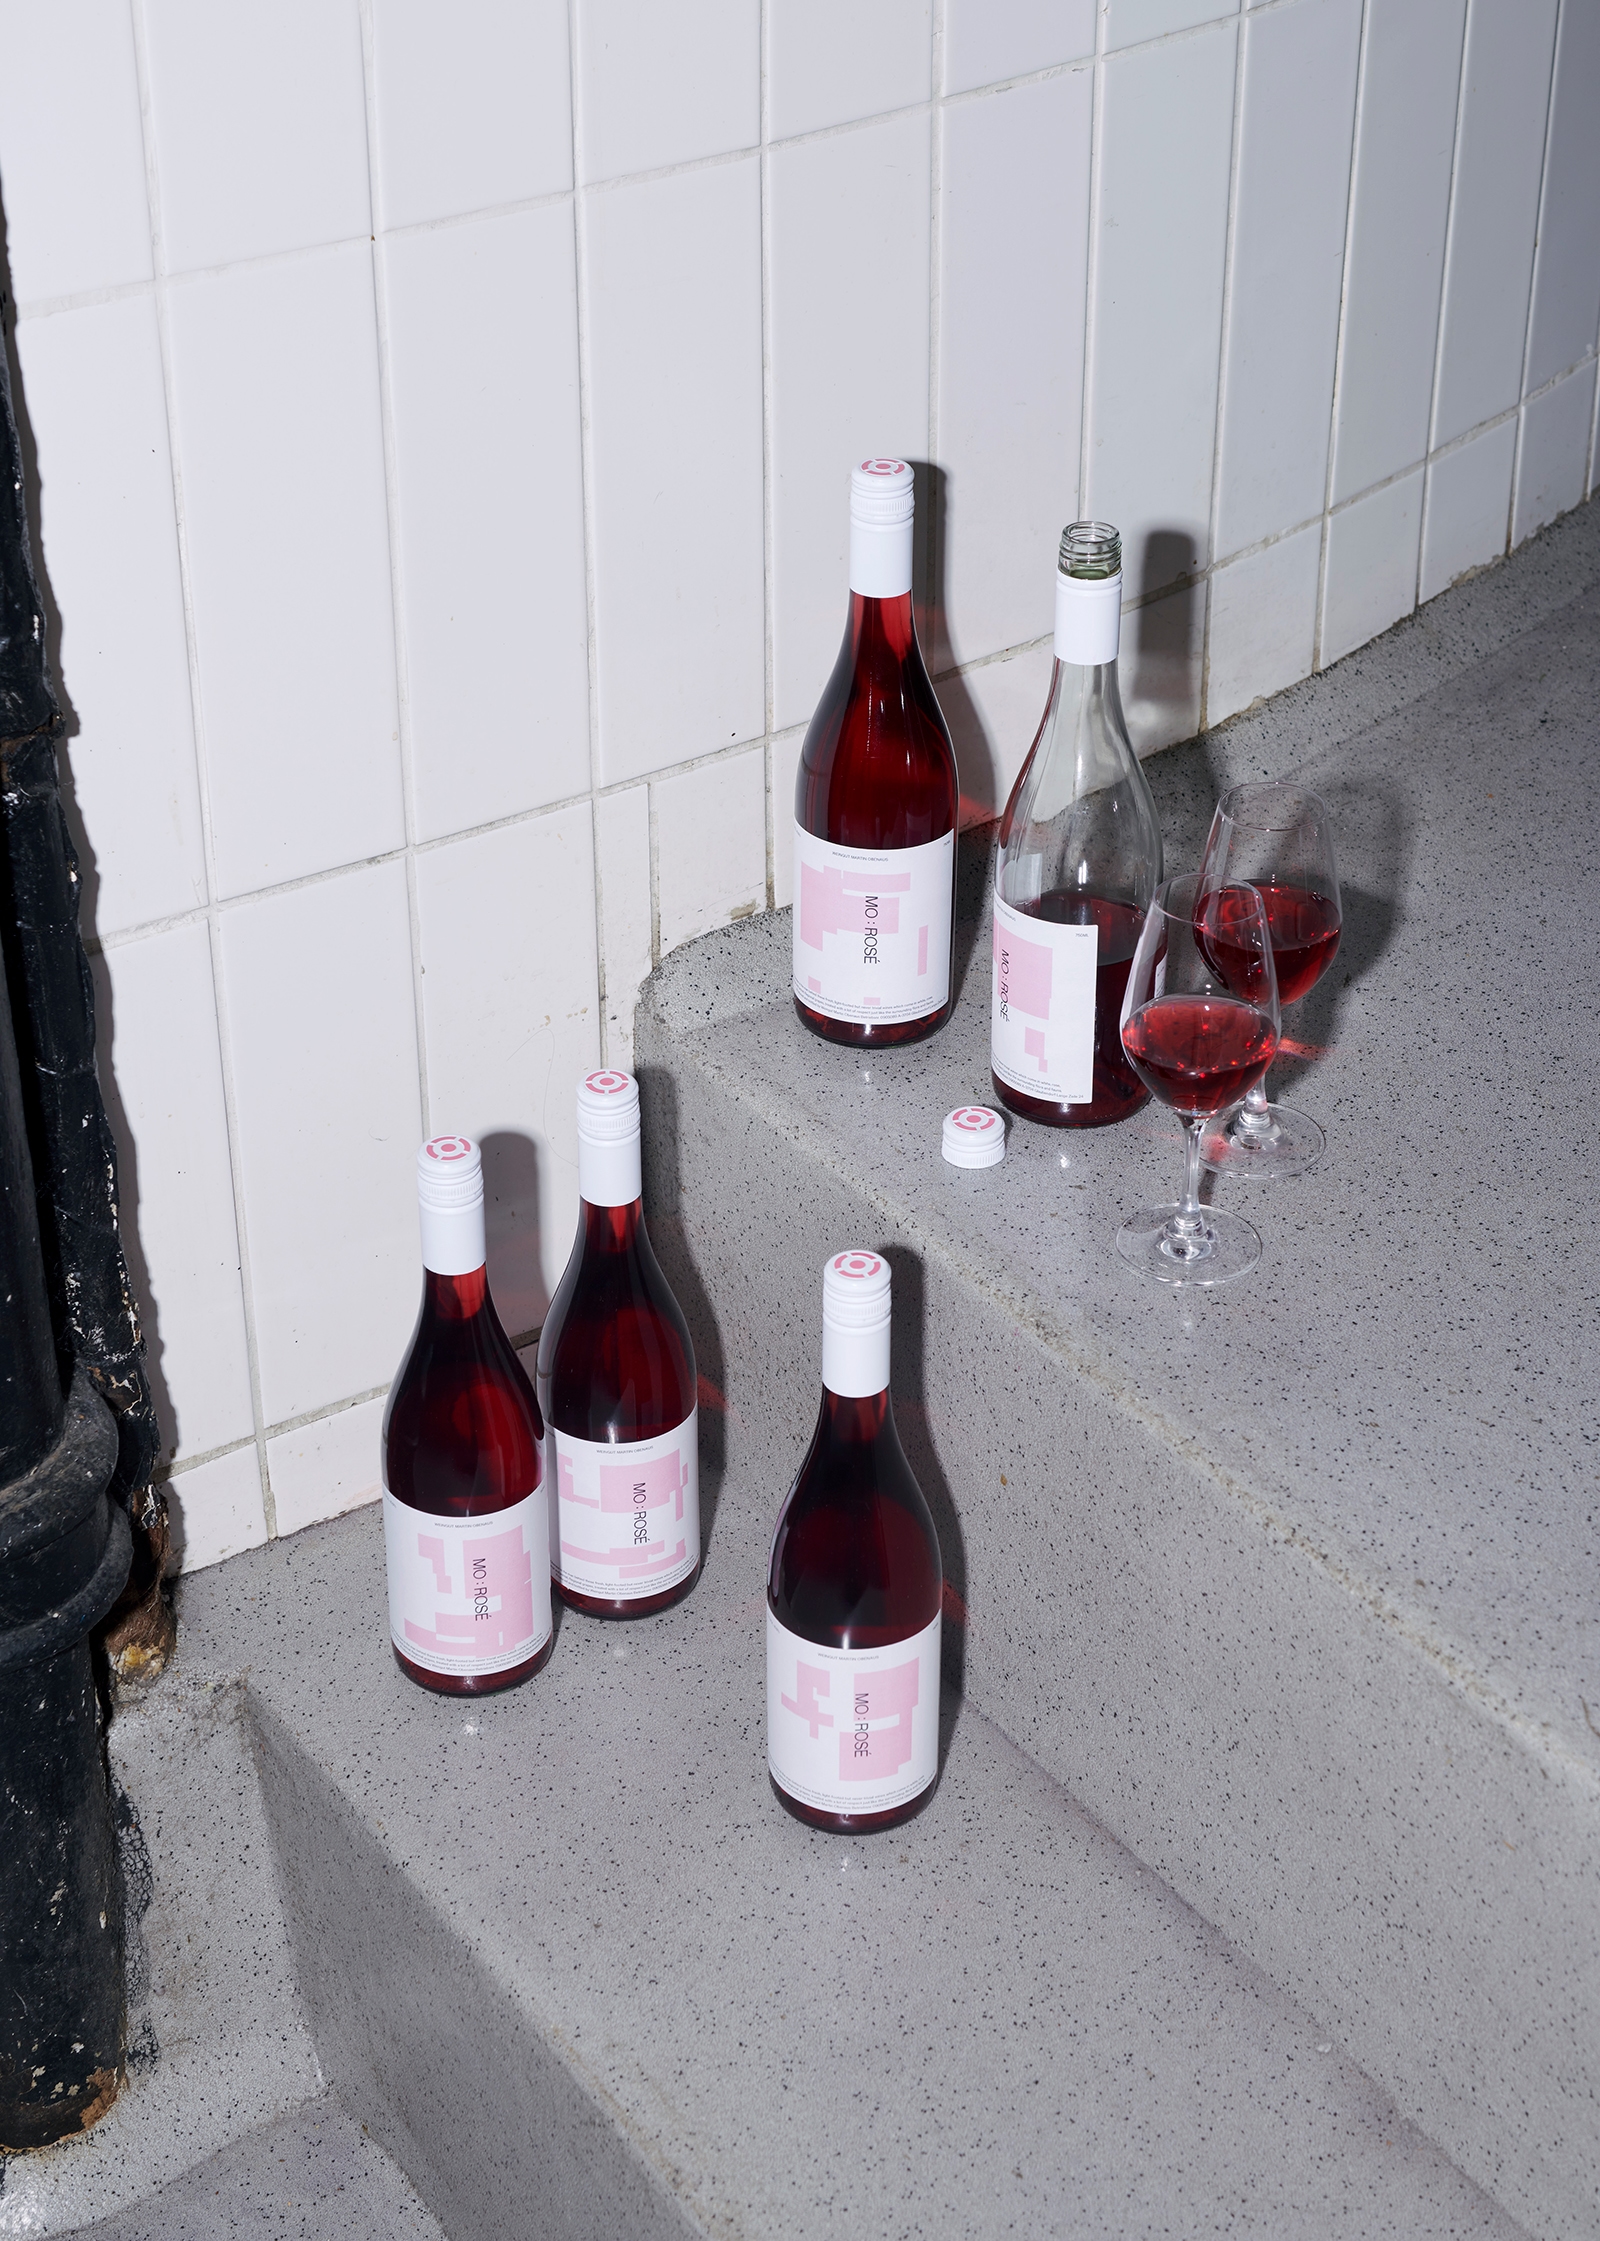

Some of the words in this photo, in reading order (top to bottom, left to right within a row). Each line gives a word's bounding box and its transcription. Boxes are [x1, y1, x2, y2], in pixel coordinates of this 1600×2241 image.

[863, 927, 881, 964] ROSÉ
[999, 982, 1010, 1022] ROSÉ
[633, 1510, 650, 1545] ROSÉ
[474, 1586, 492, 1622] ROSÉ
[854, 1722, 872, 1758] ROSÉ
